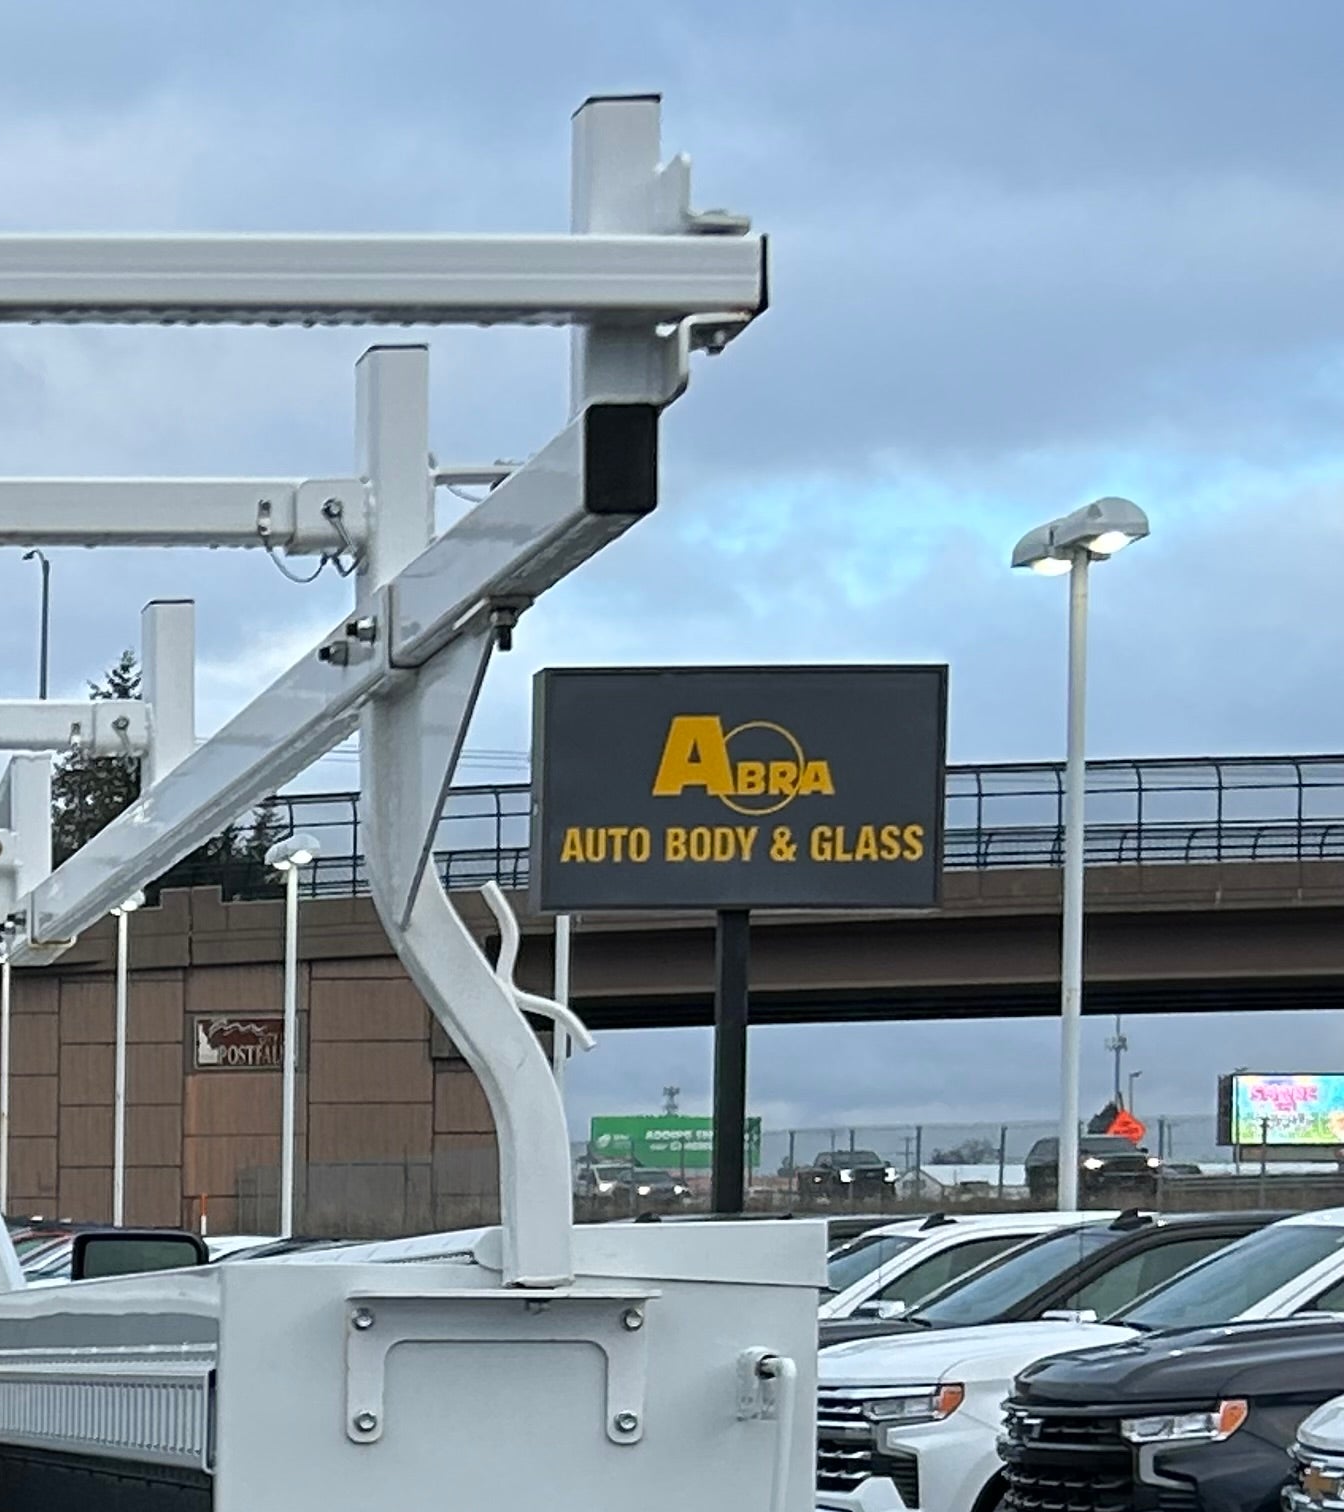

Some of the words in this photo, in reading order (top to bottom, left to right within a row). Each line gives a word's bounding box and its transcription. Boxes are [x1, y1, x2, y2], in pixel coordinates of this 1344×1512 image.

[653, 715, 835, 796] ABRA
[560, 826, 651, 864] AUTO
[665, 826, 759, 863] BODY
[770, 826, 797, 863] &
[810, 823, 924, 863] GLASS
[219, 1044, 255, 1065] POST
